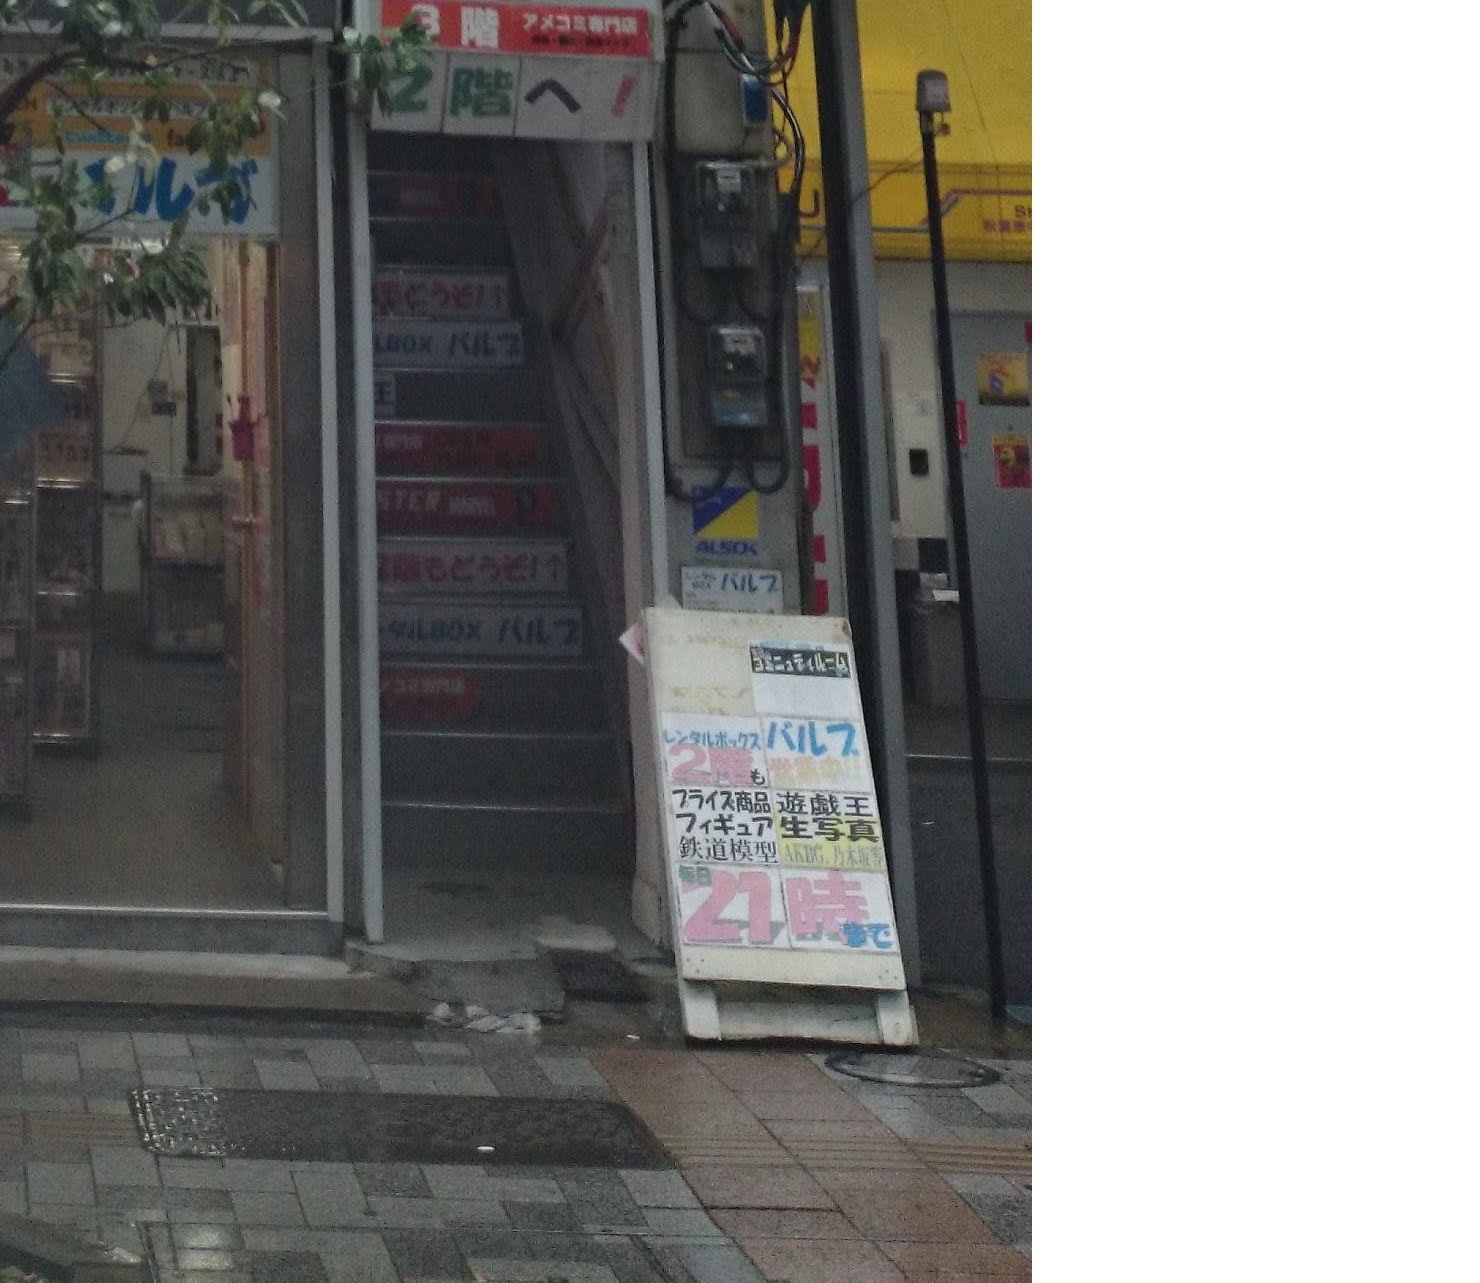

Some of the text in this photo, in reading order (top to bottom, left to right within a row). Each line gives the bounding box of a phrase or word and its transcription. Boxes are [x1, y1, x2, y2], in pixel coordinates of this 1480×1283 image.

[779, 816, 880, 843] 生写真
[678, 835, 779, 864] 鉄道模型
